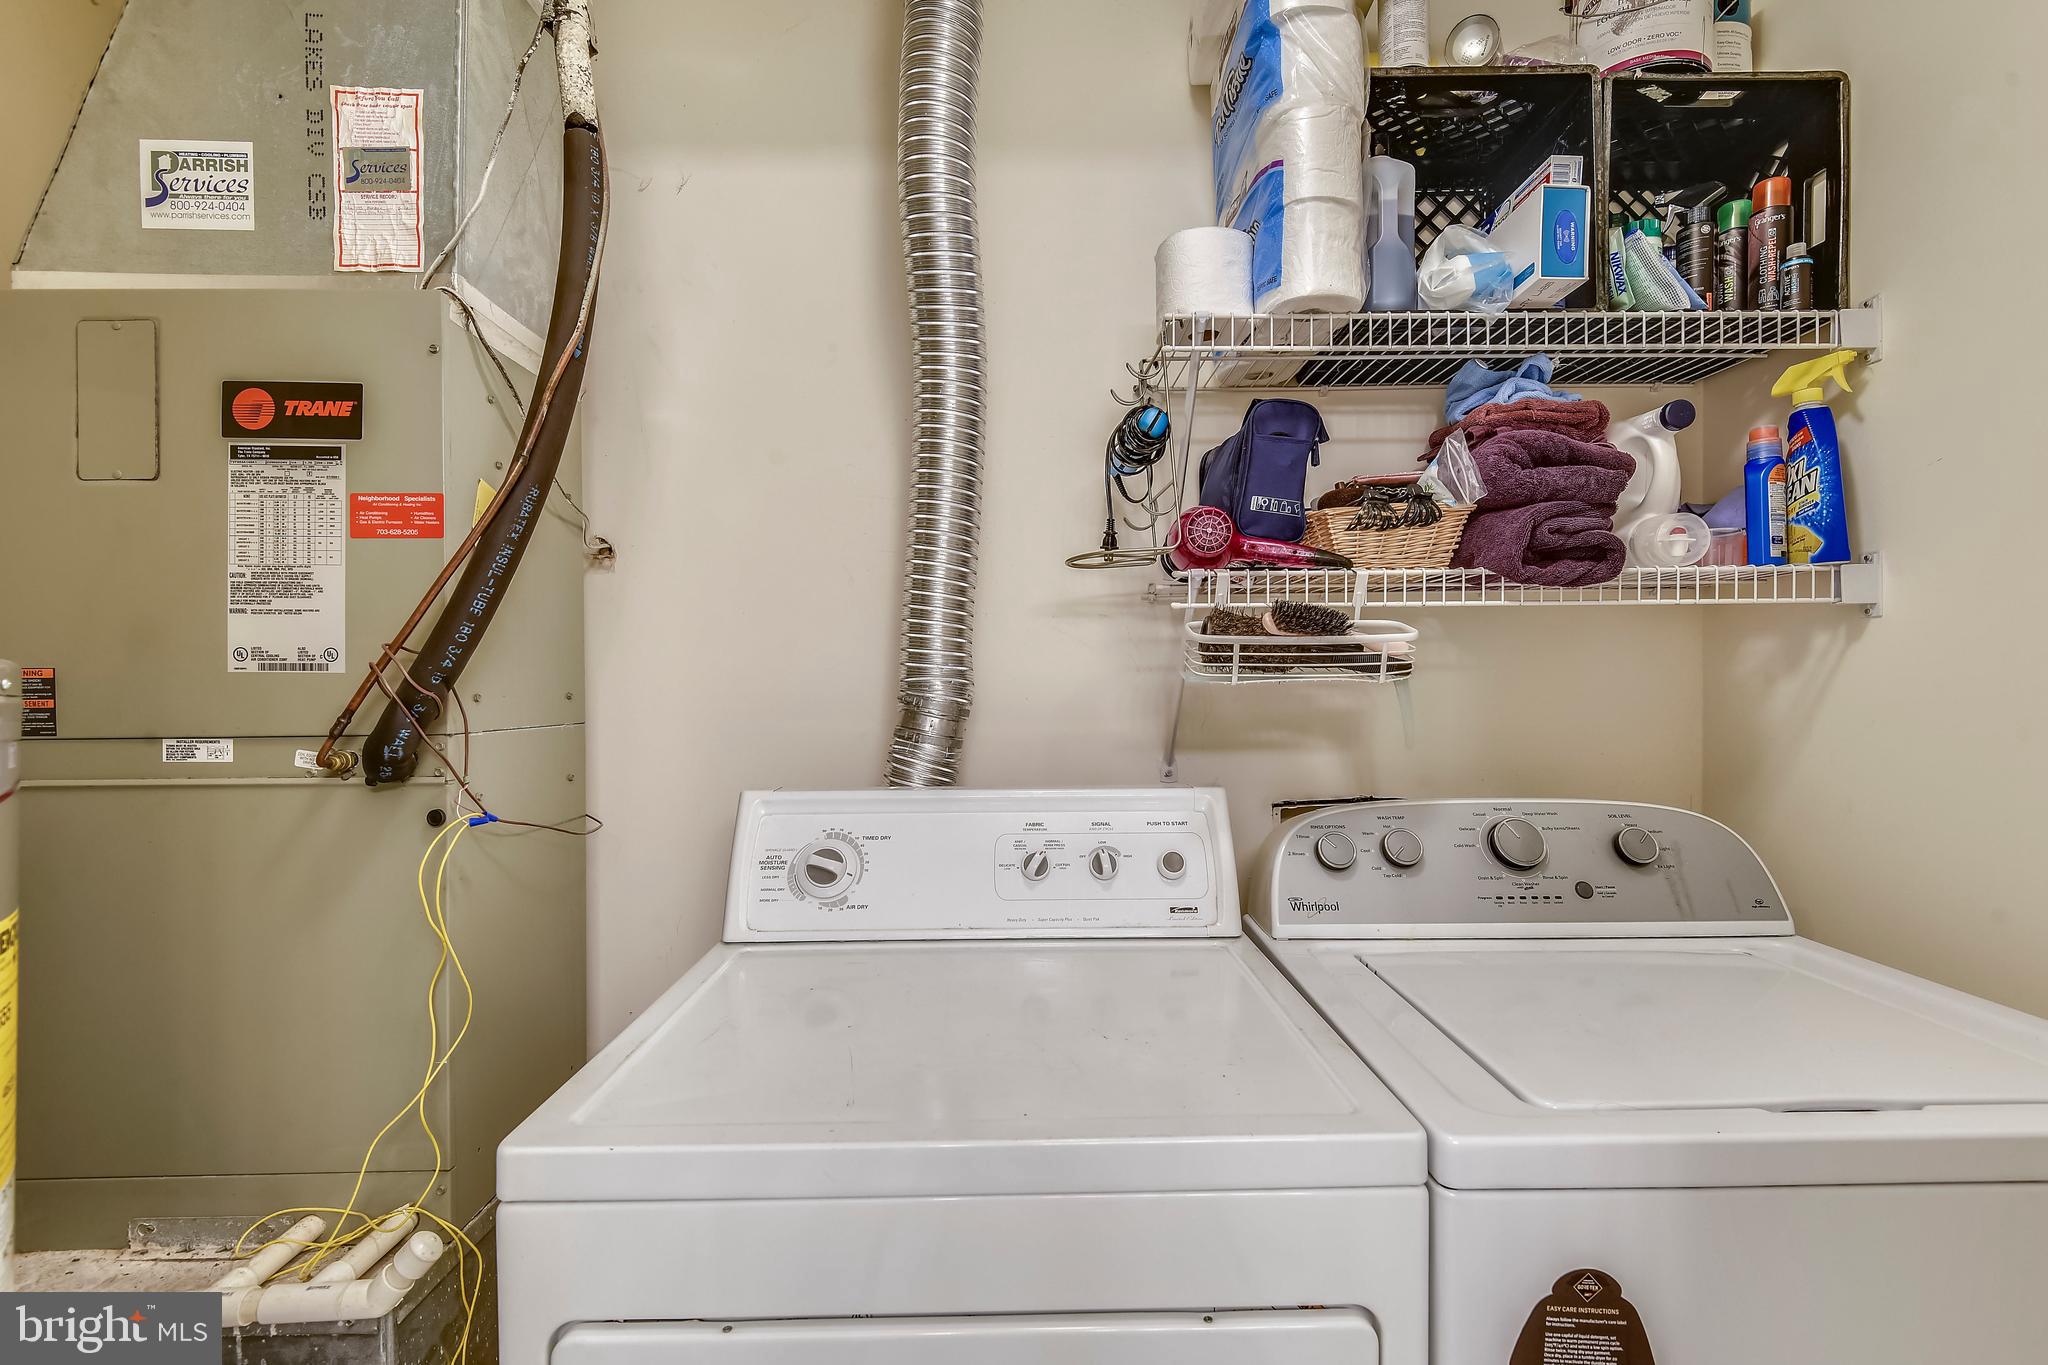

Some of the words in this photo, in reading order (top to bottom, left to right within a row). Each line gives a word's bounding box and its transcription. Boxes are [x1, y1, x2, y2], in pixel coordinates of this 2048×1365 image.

[1607, 45, 1621, 55] LOW
[1622, 37, 1642, 48] ODOR
[1647, 32, 1665, 41] ZERO
[151, 151, 248, 190] PARRISH
[346, 160, 407, 184] Services
[145, 169, 249, 207] Services
[150, 211, 251, 220] www.parrishservices.com
[170, 200, 245, 211] 800-924-0404
[1759, 245, 1768, 285] CLOTHING
[1767, 236, 1777, 283] WASH+REPEL
[1609, 251, 1626, 296] NIKWAX
[1724, 277, 1734, 303] WASH
[283, 400, 354, 417] TRANE
[357, 495, 400, 503] Neighborhood
[441, 645, 463, 669] 3/4
[1289, 900, 1340, 914] Whirlpool
[1578, 1307, 1619, 1315] INSTRUCTIONS
